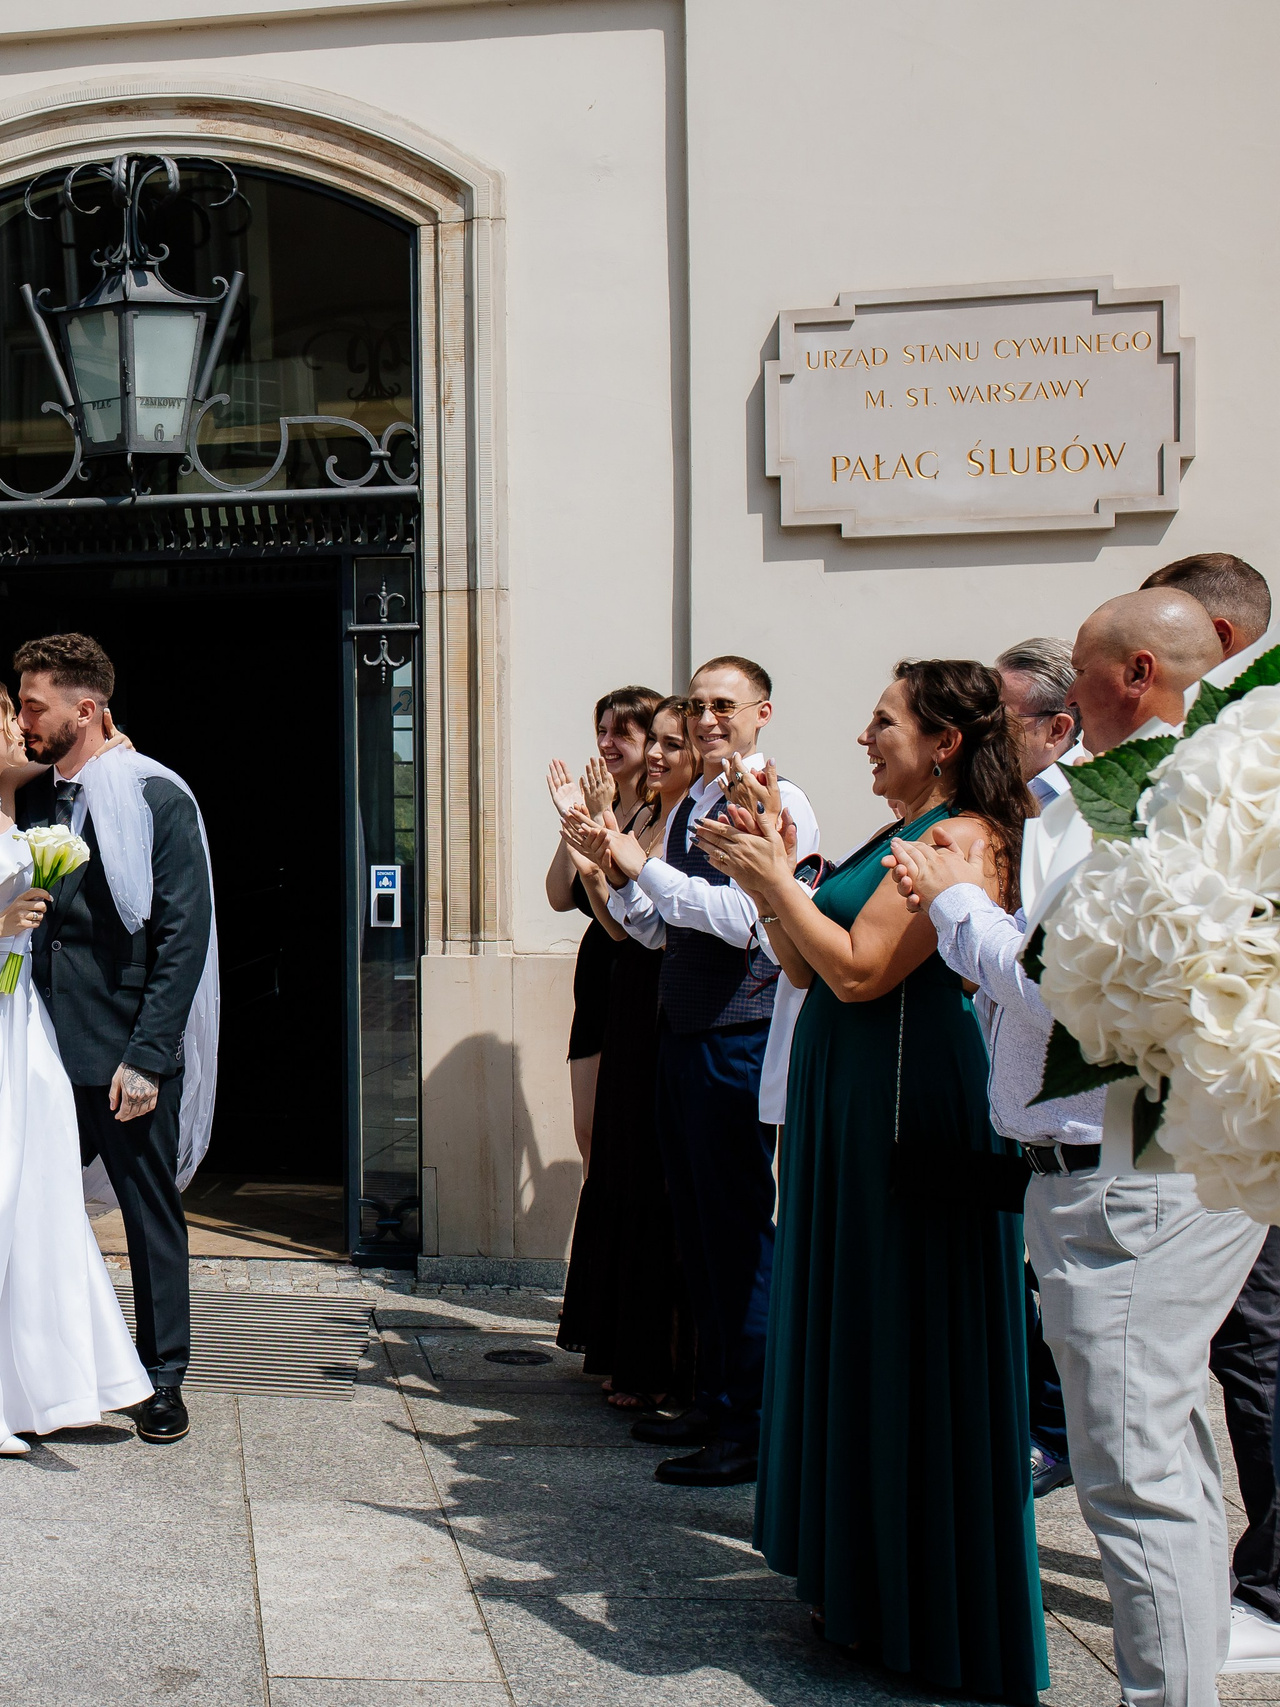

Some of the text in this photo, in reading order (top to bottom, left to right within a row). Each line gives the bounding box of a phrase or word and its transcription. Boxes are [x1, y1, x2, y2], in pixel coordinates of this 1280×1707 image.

[806, 330, 1152, 371] URZĄD STANU CYWILNEGO
[92, 397, 182, 410] PLAC ZAMKOWY
[864, 378, 1090, 409] M. ST. WARSZAWY
[154, 423, 165, 442] 6
[831, 434, 1126, 483] PAŁAC ŚLUBÓW
